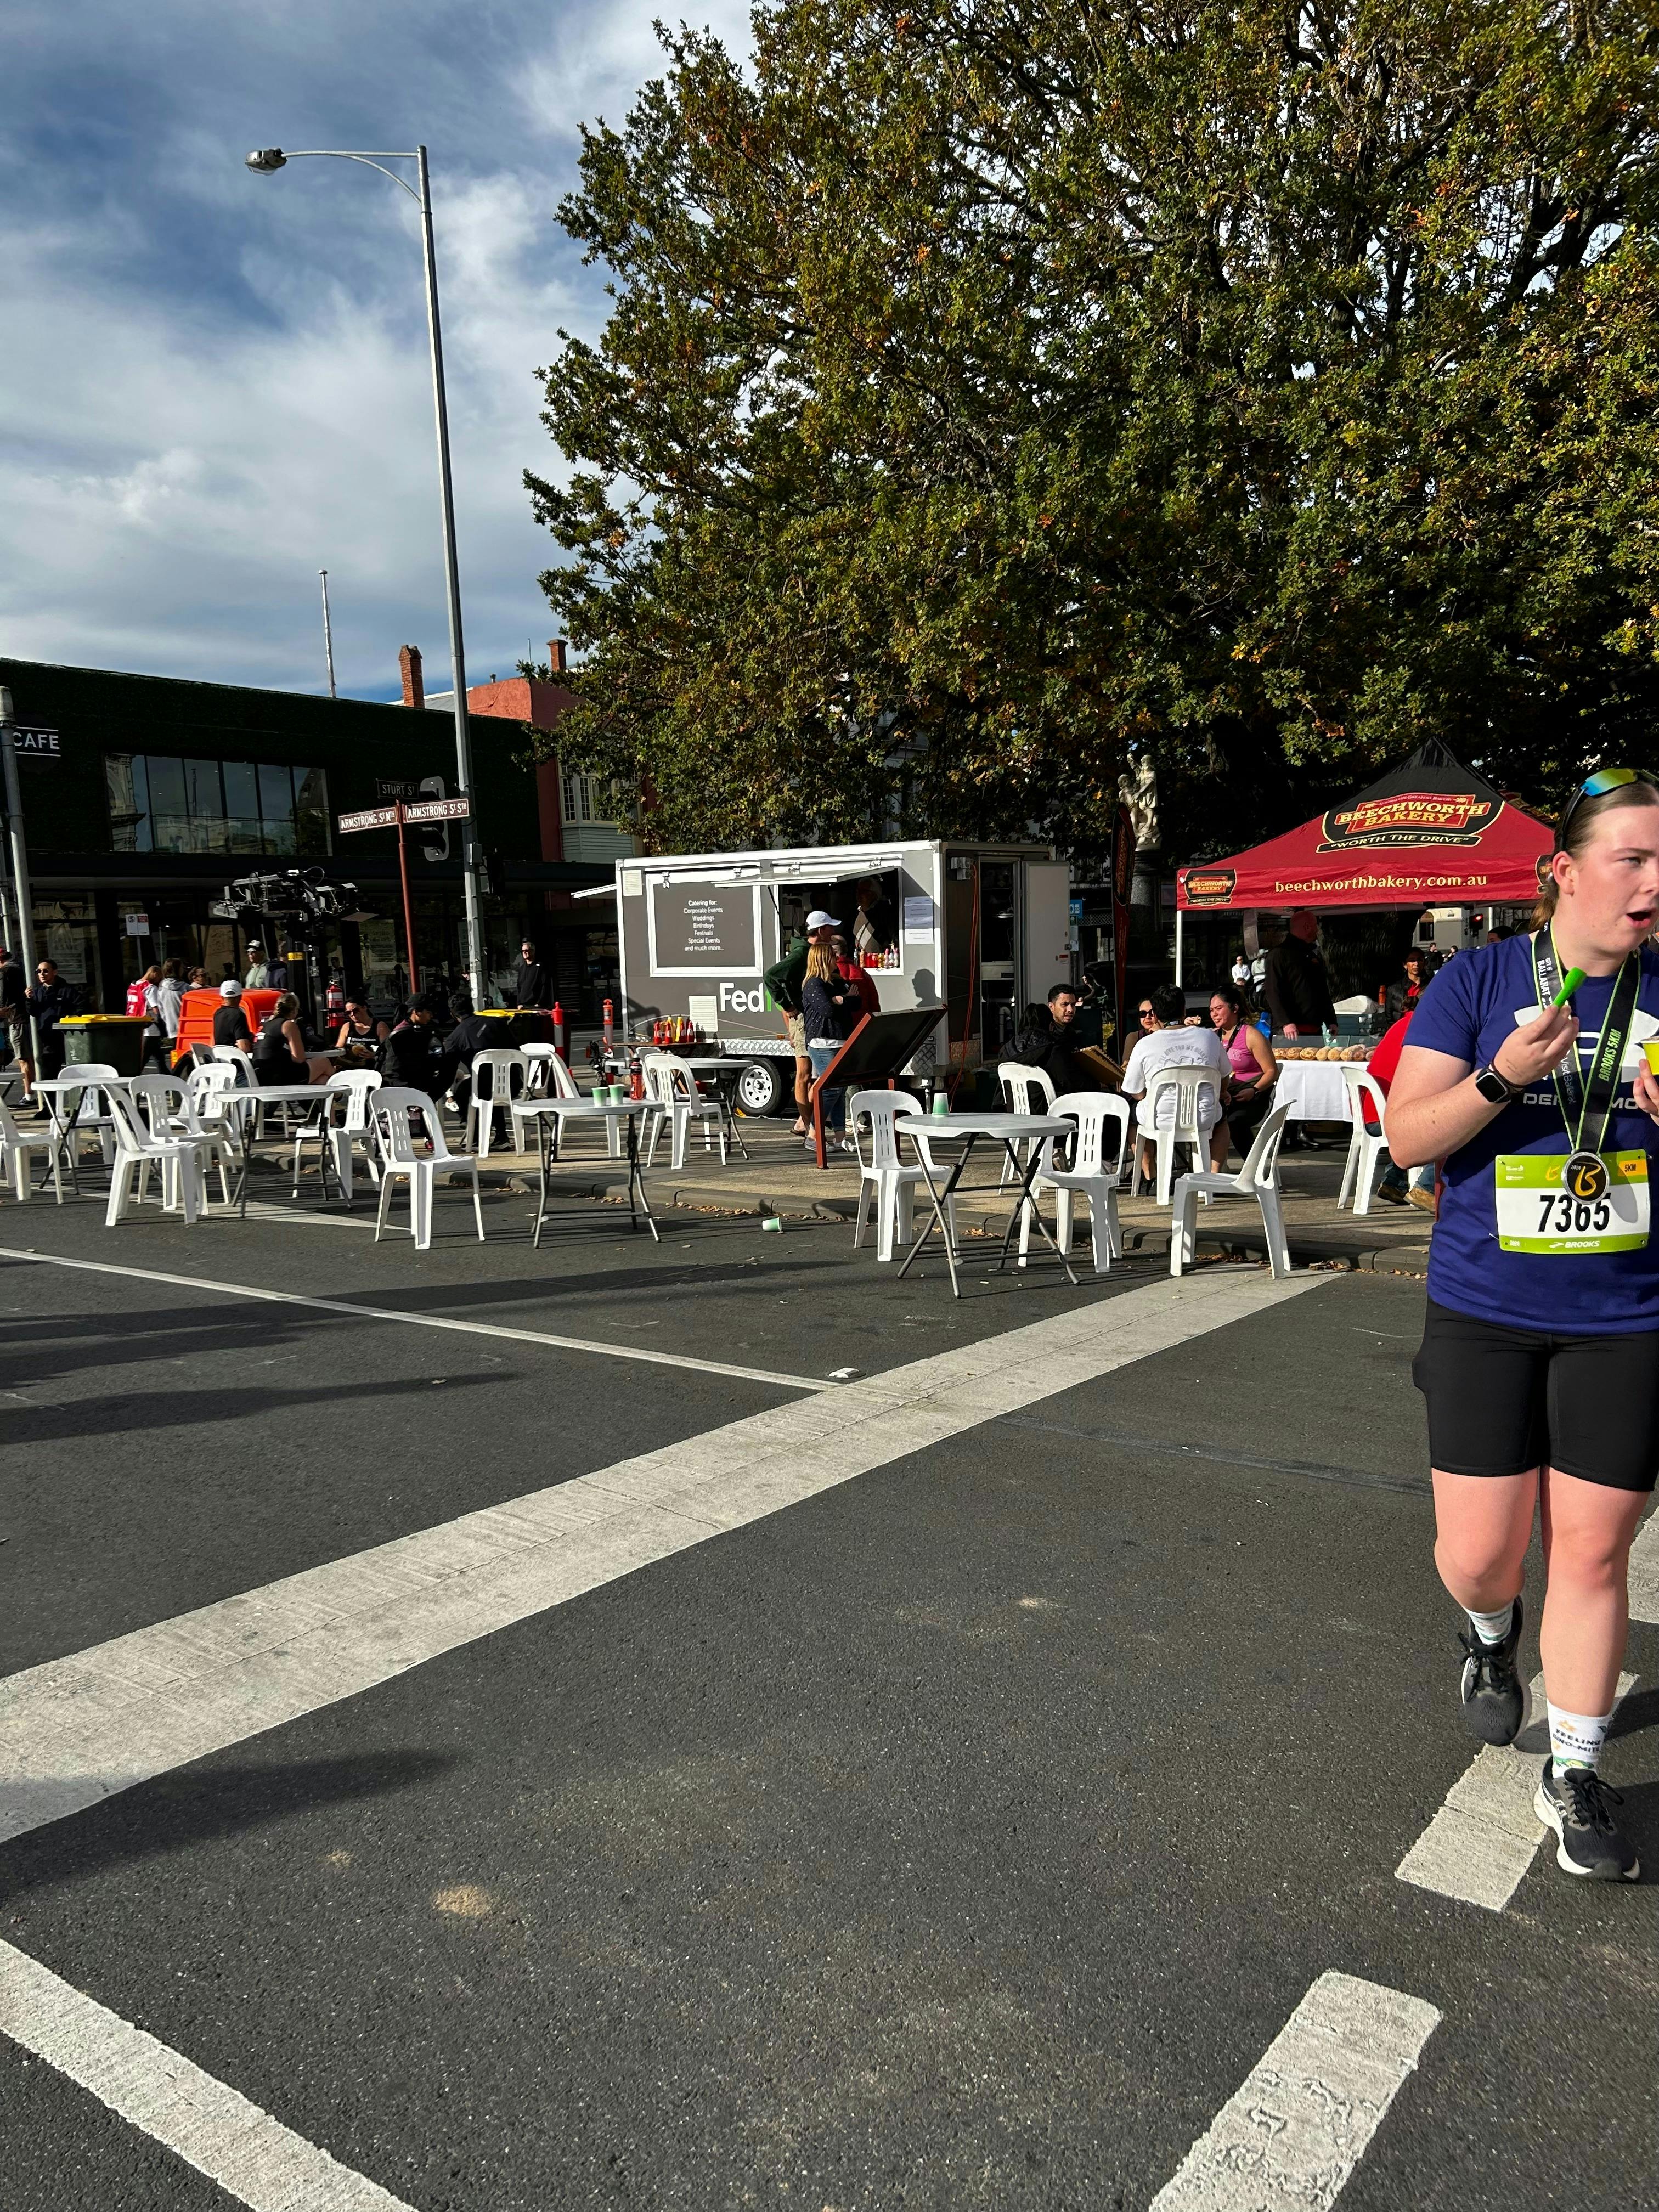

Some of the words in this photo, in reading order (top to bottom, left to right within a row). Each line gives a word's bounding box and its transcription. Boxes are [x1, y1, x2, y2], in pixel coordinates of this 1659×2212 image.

[13, 732, 60, 749] CAFE
[382, 785, 404, 795] STURT
[408, 805, 447, 818] ARMSTRONG
[1339, 802, 1486, 823] BEECHWORTH
[1364, 810, 1452, 827] BAKERY
[341, 814, 377, 829] ARMSTRONG
[1275, 876, 1487, 893] beechworthbakery.com.au
[1537, 960, 1551, 995] BALLARAT
[1607, 1028, 1622, 1048] 5KM
[1598, 1047, 1617, 1082] BROOKS
[1624, 1163, 1637, 1172] 5KM
[1538, 1192, 1611, 1232] 7365
[1564, 1240, 1600, 1248] BROOKS
[1556, 1729, 1601, 1745] FEELING
